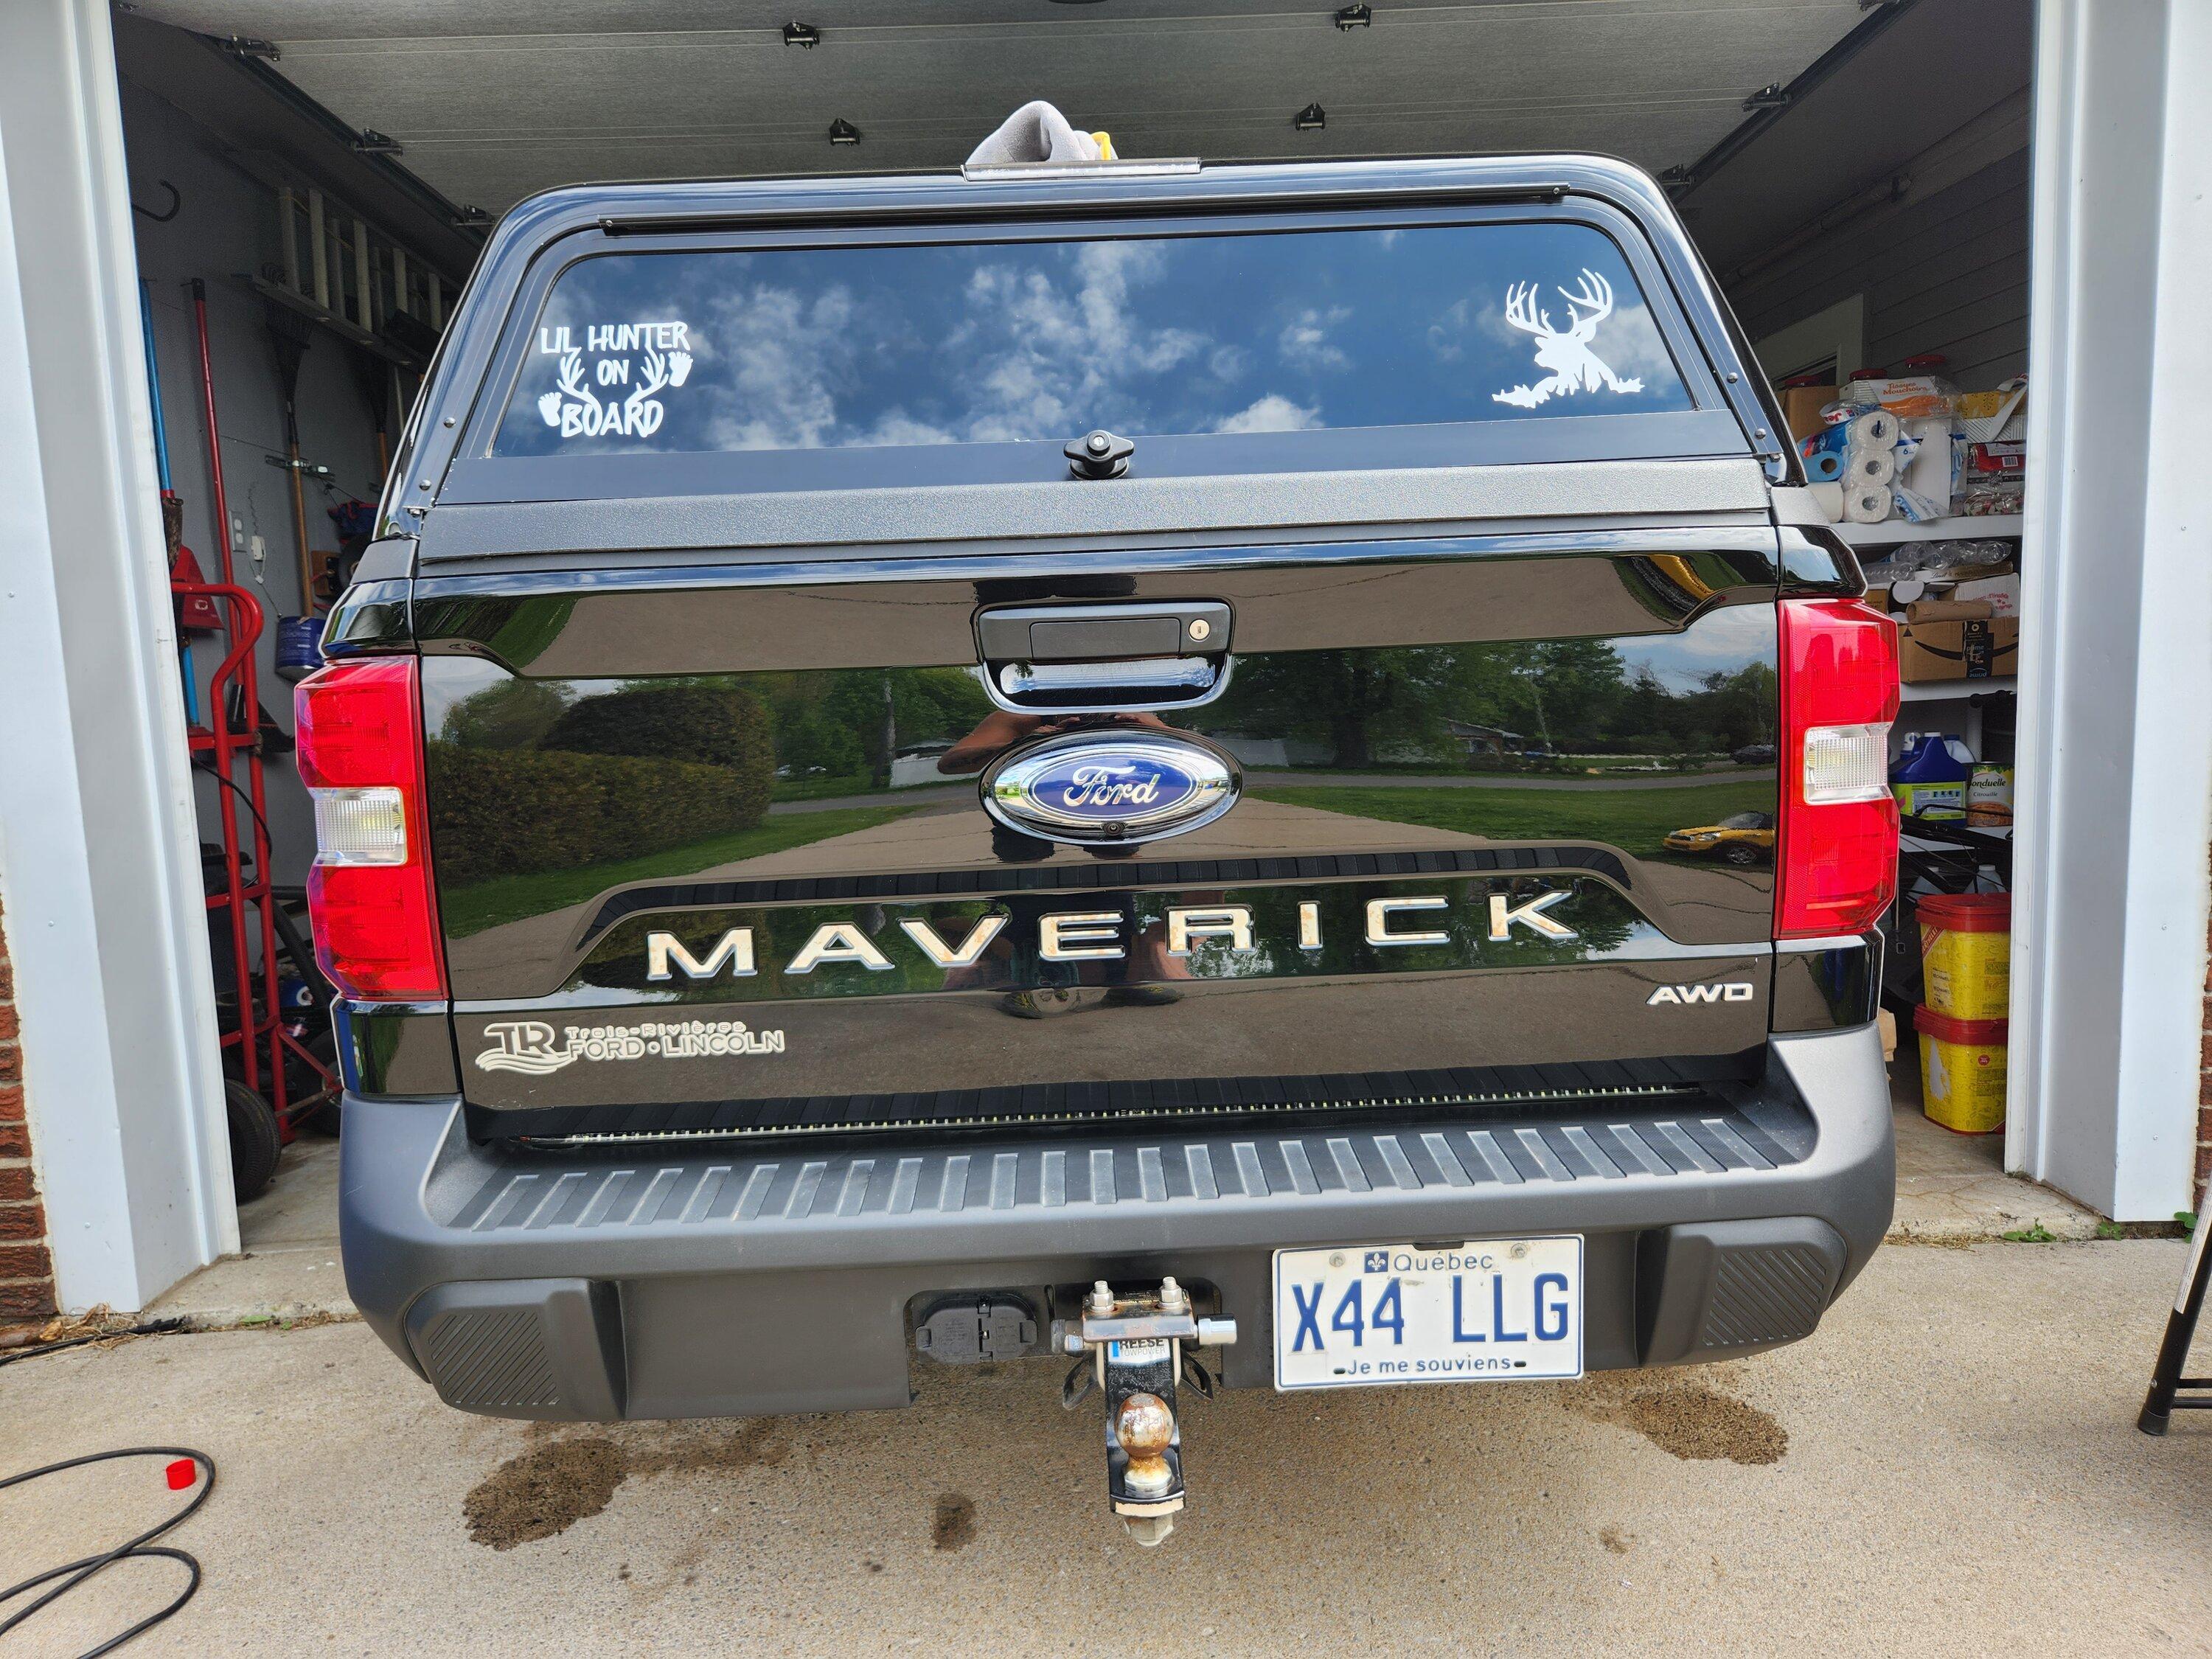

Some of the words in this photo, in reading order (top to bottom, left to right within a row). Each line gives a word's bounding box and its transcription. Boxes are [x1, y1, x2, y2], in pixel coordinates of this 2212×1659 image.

[540, 327, 582, 353] LIL
[588, 321, 691, 352] HUNTER
[597, 359, 629, 386] ON
[1883, 385, 1927, 395] Mouchoirs
[561, 400, 664, 438] BOARD
[1063, 765, 1160, 807] Ford
[1970, 778, 2006, 789] onduelle
[647, 890, 1579, 981] MAVERICK
[1646, 983, 1753, 1005] AWD
[564, 1020, 747, 1040] Trois-Rivières
[566, 1037, 644, 1060] FORD
[661, 1029, 786, 1058] LINCOLN
[1394, 1251, 1494, 1271] Québec
[1292, 1276, 1405, 1352] X44
[1452, 1273, 1569, 1343] LLG
[1120, 1338, 1164, 1349] REESE
[1120, 1347, 1166, 1357] TOWPOWER
[1348, 1358, 1371, 1375] Je
[1379, 1358, 1408, 1373] me
[1416, 1354, 1512, 1372] souviens
